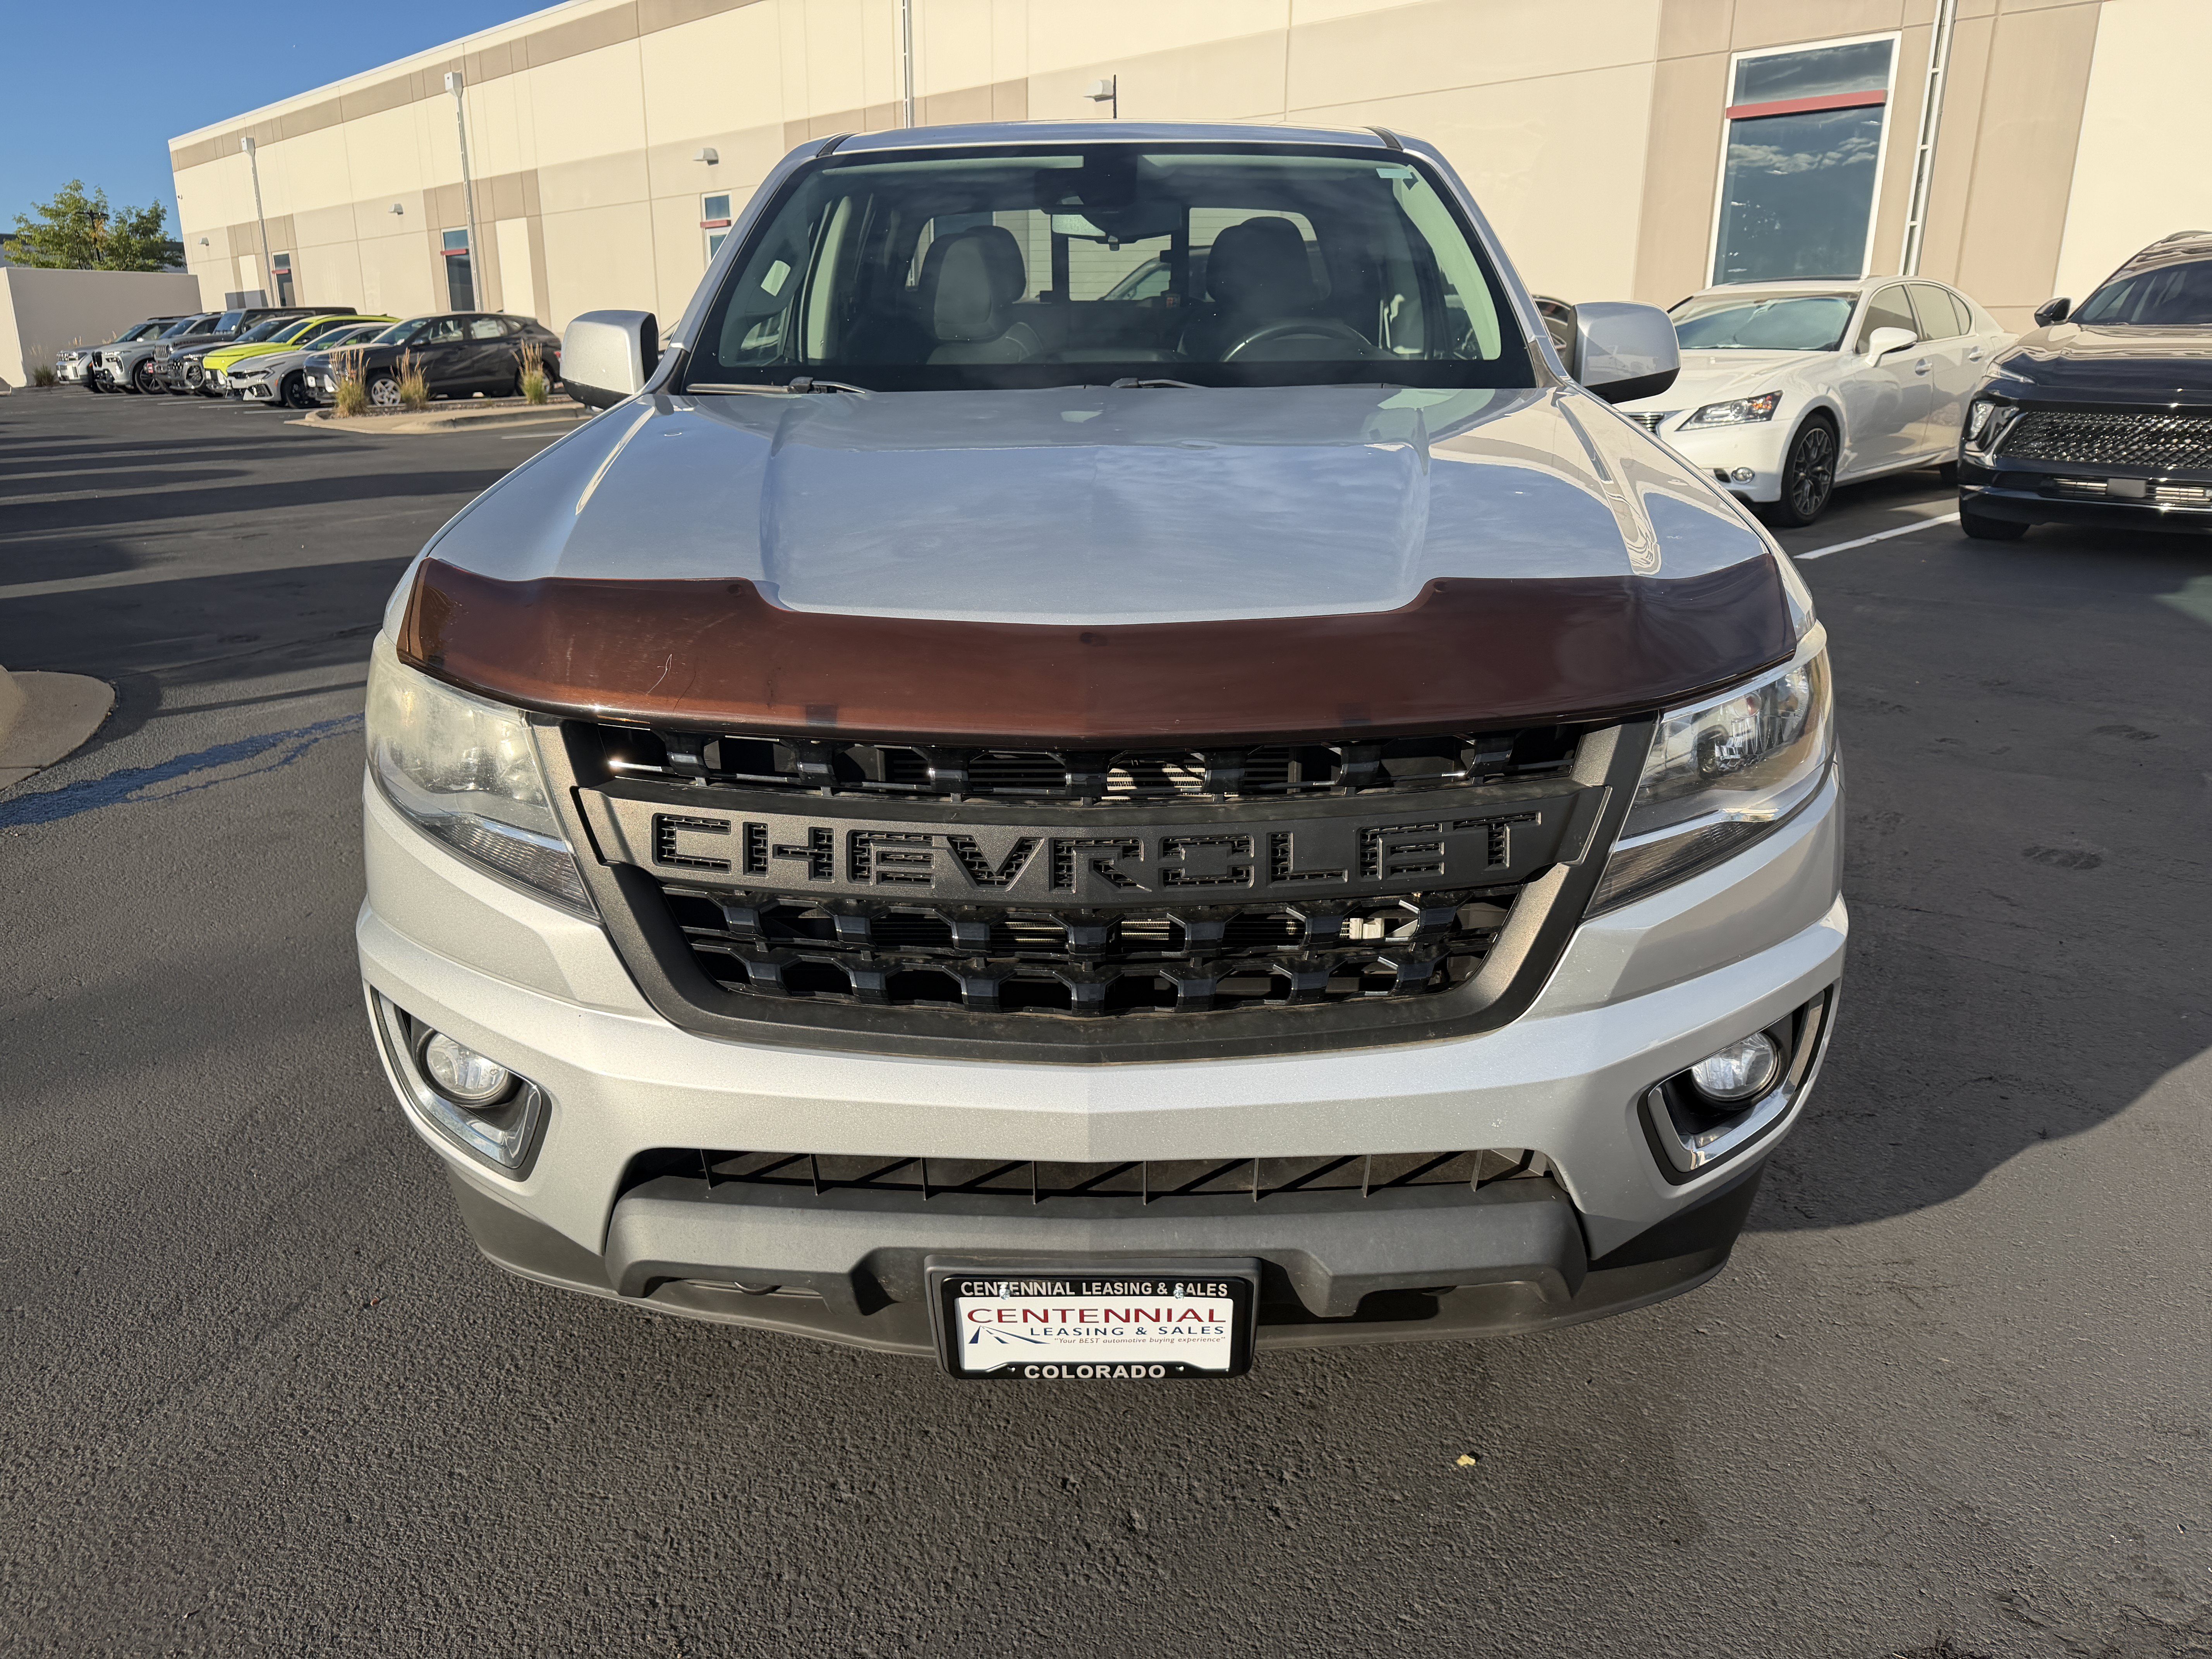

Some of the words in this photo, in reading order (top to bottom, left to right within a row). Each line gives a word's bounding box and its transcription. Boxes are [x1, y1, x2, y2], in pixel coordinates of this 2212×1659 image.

[652, 811, 1542, 893] CHEVROLET
[960, 1281, 1075, 1296] CENTENNIAL
[1082, 1282, 1152, 1295] LEASING
[1157, 1282, 1168, 1295] &
[1174, 1283, 1228, 1297] SALES
[967, 1308, 1226, 1323] CENTENNIAL
[1030, 1327, 1123, 1336] LEASING
[1135, 1327, 1147, 1335] &
[1158, 1326, 1224, 1334] SALES
[1024, 1365, 1166, 1379] COLORADO
